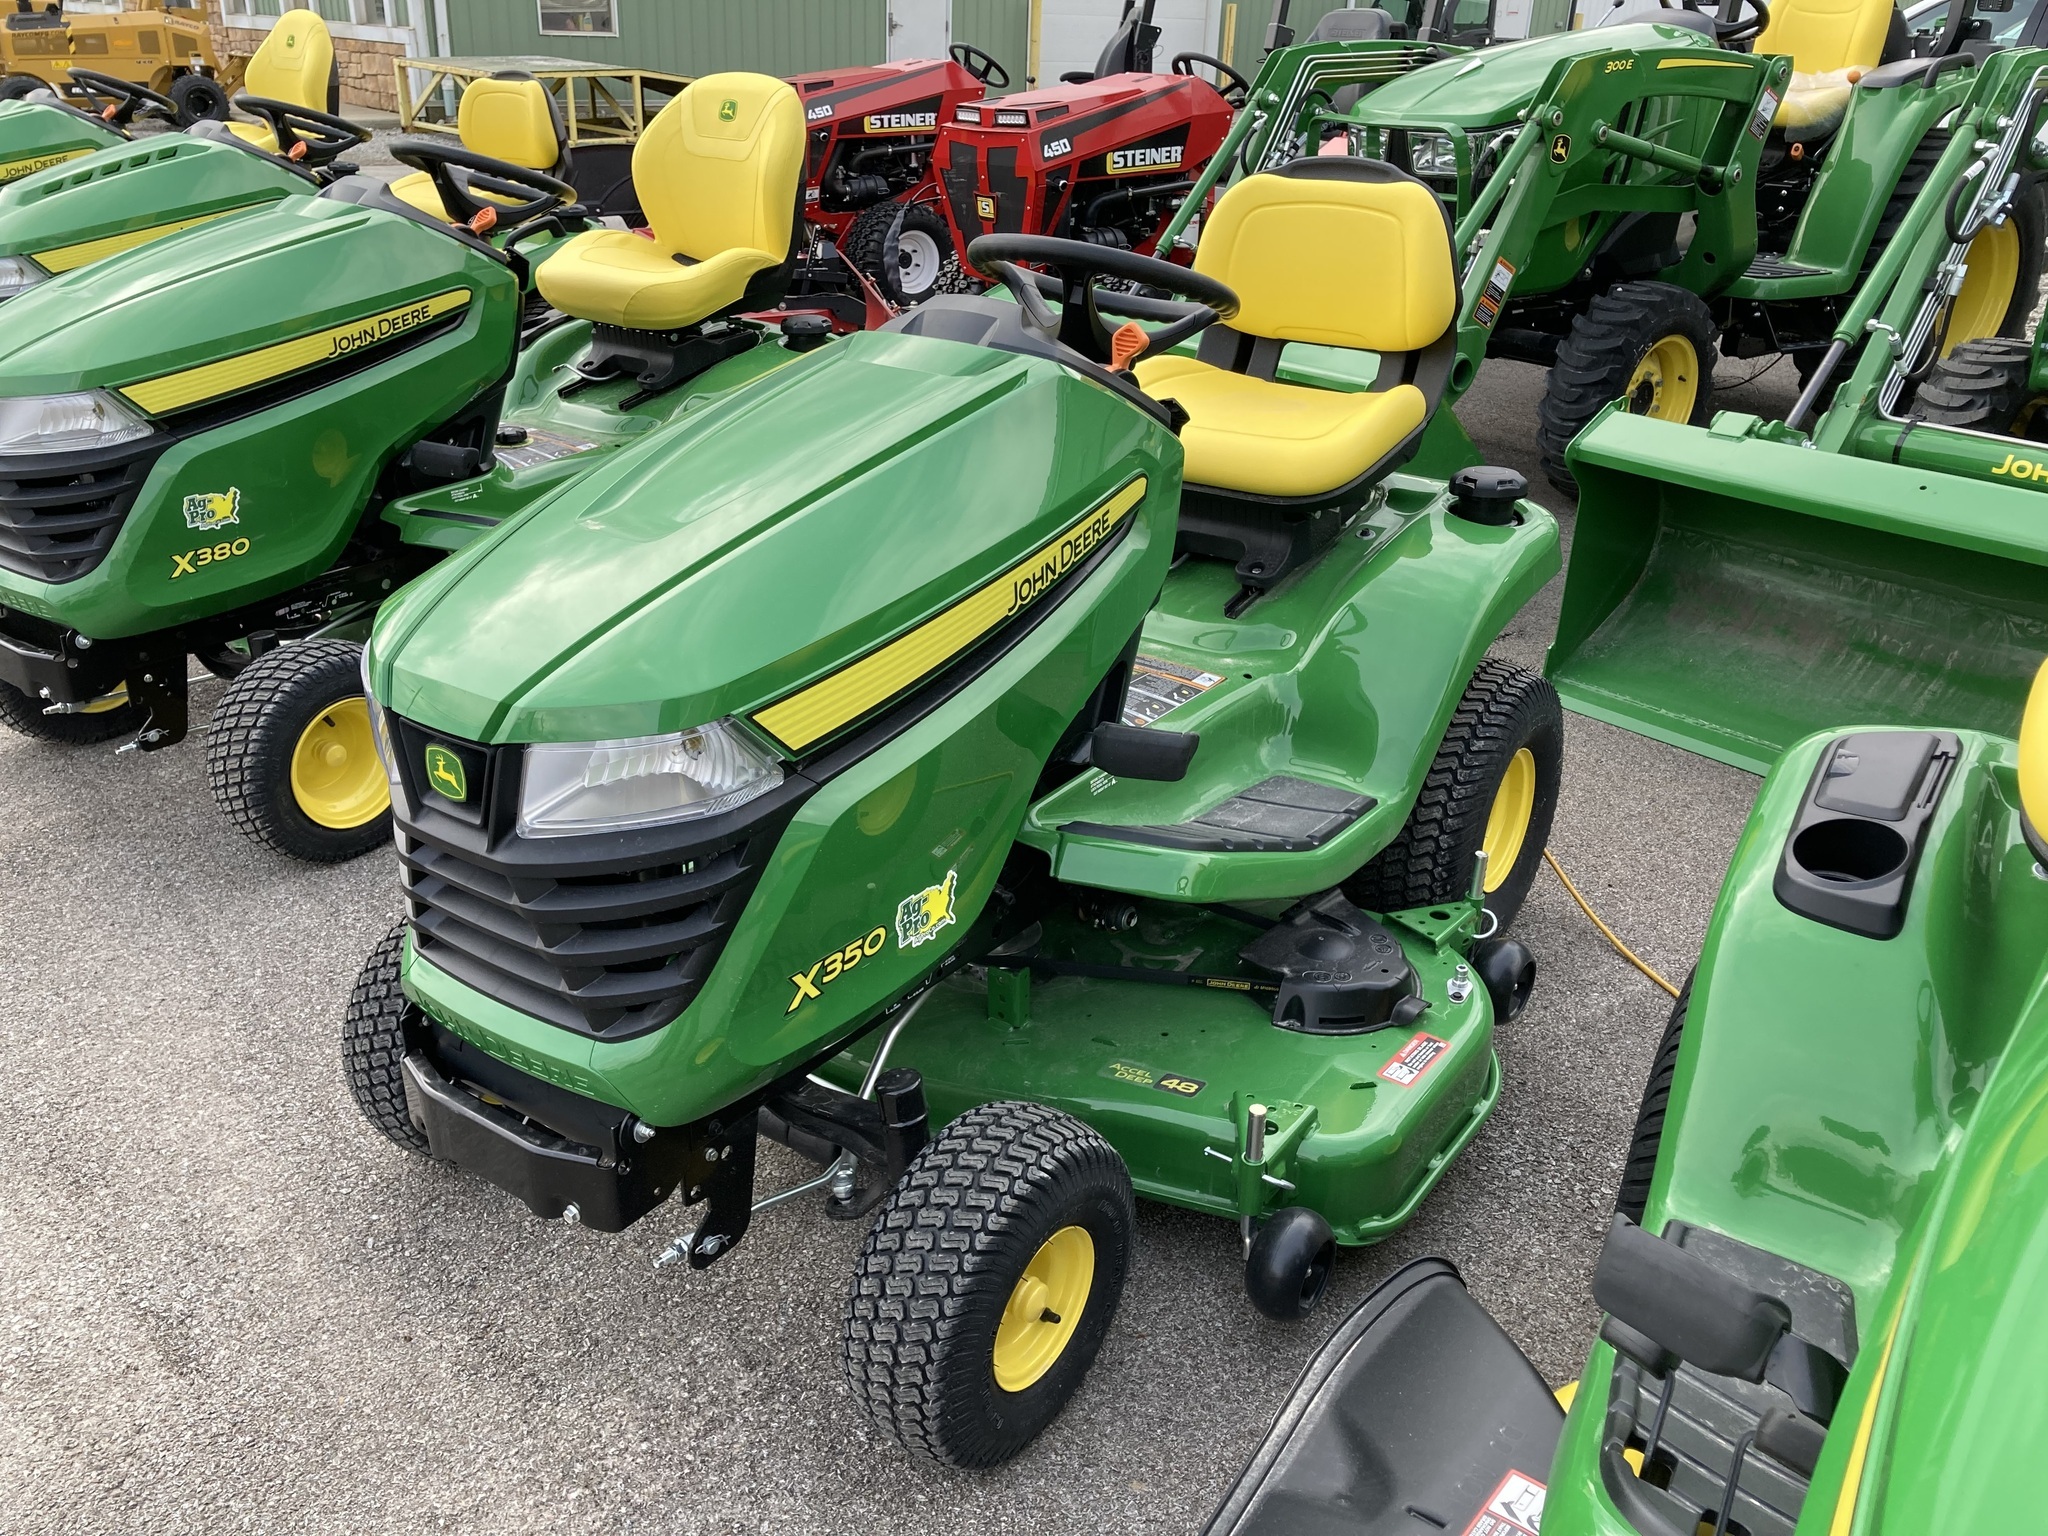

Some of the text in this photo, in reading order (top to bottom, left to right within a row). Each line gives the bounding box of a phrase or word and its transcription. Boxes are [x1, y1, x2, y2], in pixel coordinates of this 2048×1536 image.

[808, 105, 833, 120] 450
[870, 113, 936, 128] STEINER
[1043, 138, 1072, 158] 450
[1113, 146, 1182, 168] STEINER
[3, 155, 68, 178] JOHN DEERE
[328, 305, 432, 357] JOHN DEERE
[189, 510, 215, 523] Pro
[169, 537, 250, 579] X380
[1007, 509, 1111, 614] JOHN DEERE
[902, 913, 930, 943] Pro
[785, 925, 887, 1015] X350
[479, 1029, 595, 1096] DEERE
[1109, 1063, 1152, 1078] ACCEL
[1114, 1071, 1199, 1093] DEEP 48
